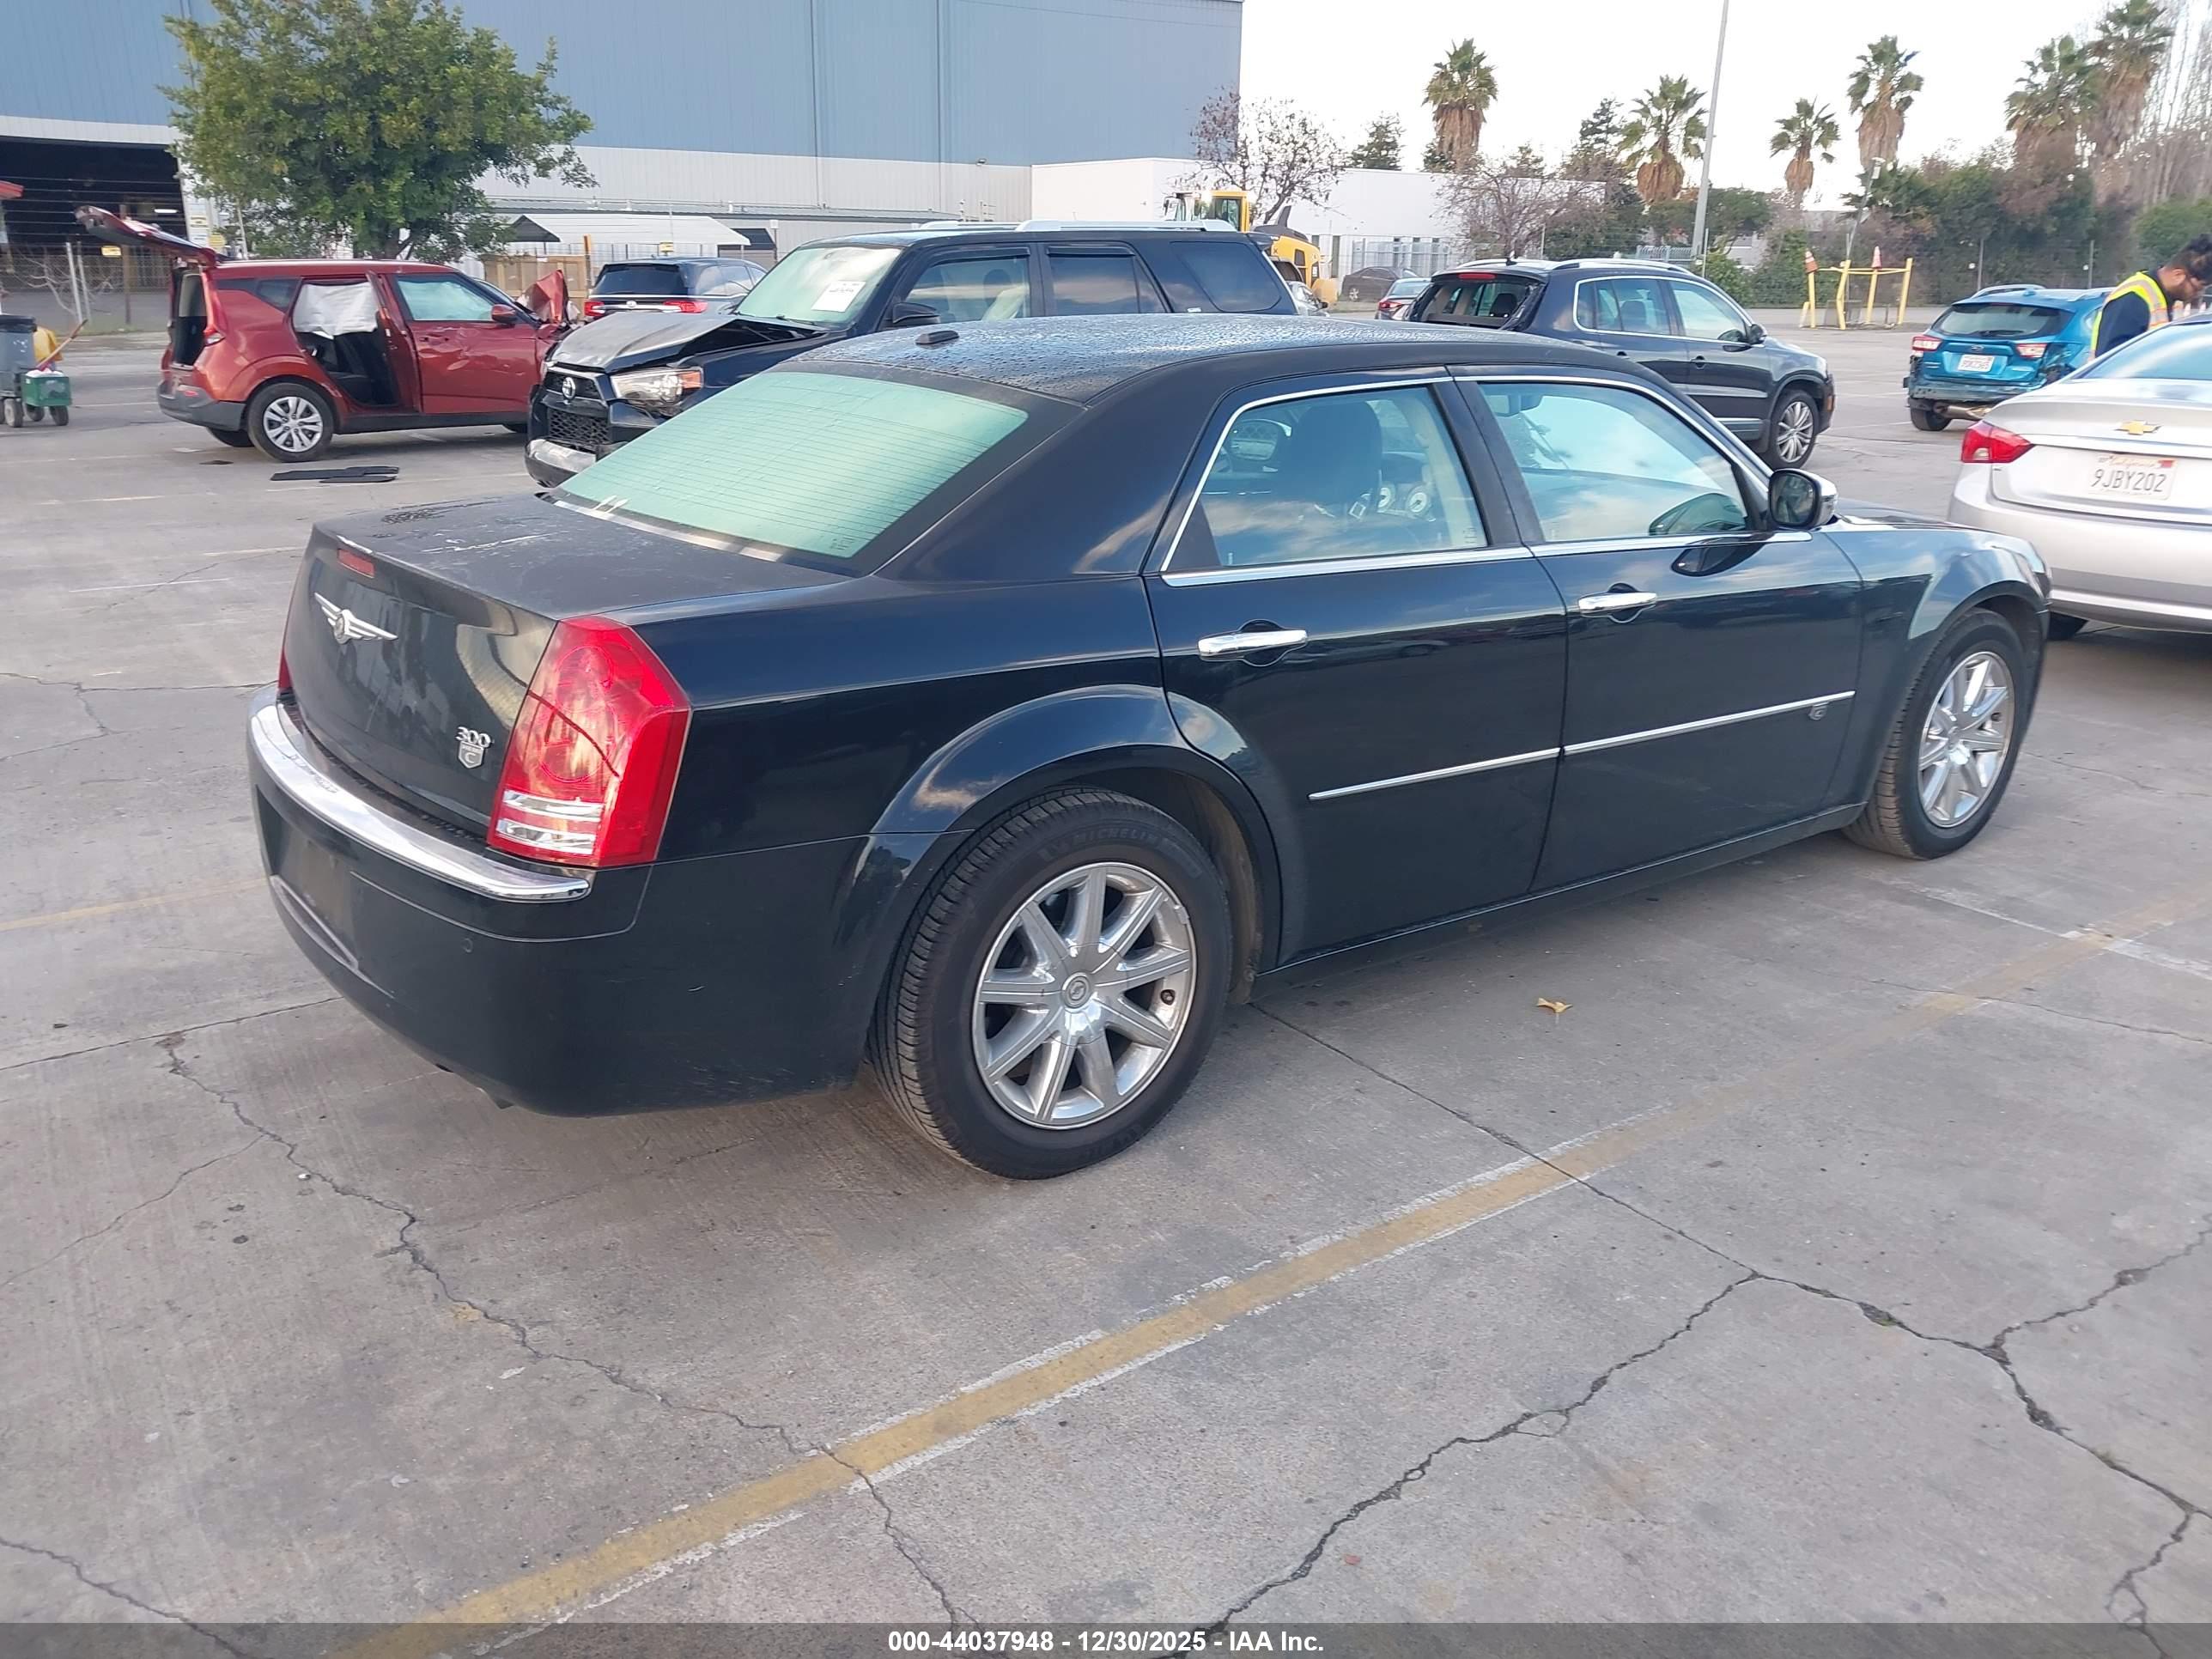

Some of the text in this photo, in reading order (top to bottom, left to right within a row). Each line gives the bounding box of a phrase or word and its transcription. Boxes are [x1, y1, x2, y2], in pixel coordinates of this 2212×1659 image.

[2090, 468, 2167, 493] 9JBY202
[455, 726, 492, 748] 300
[1073, 827, 1162, 847] MICHELIN
